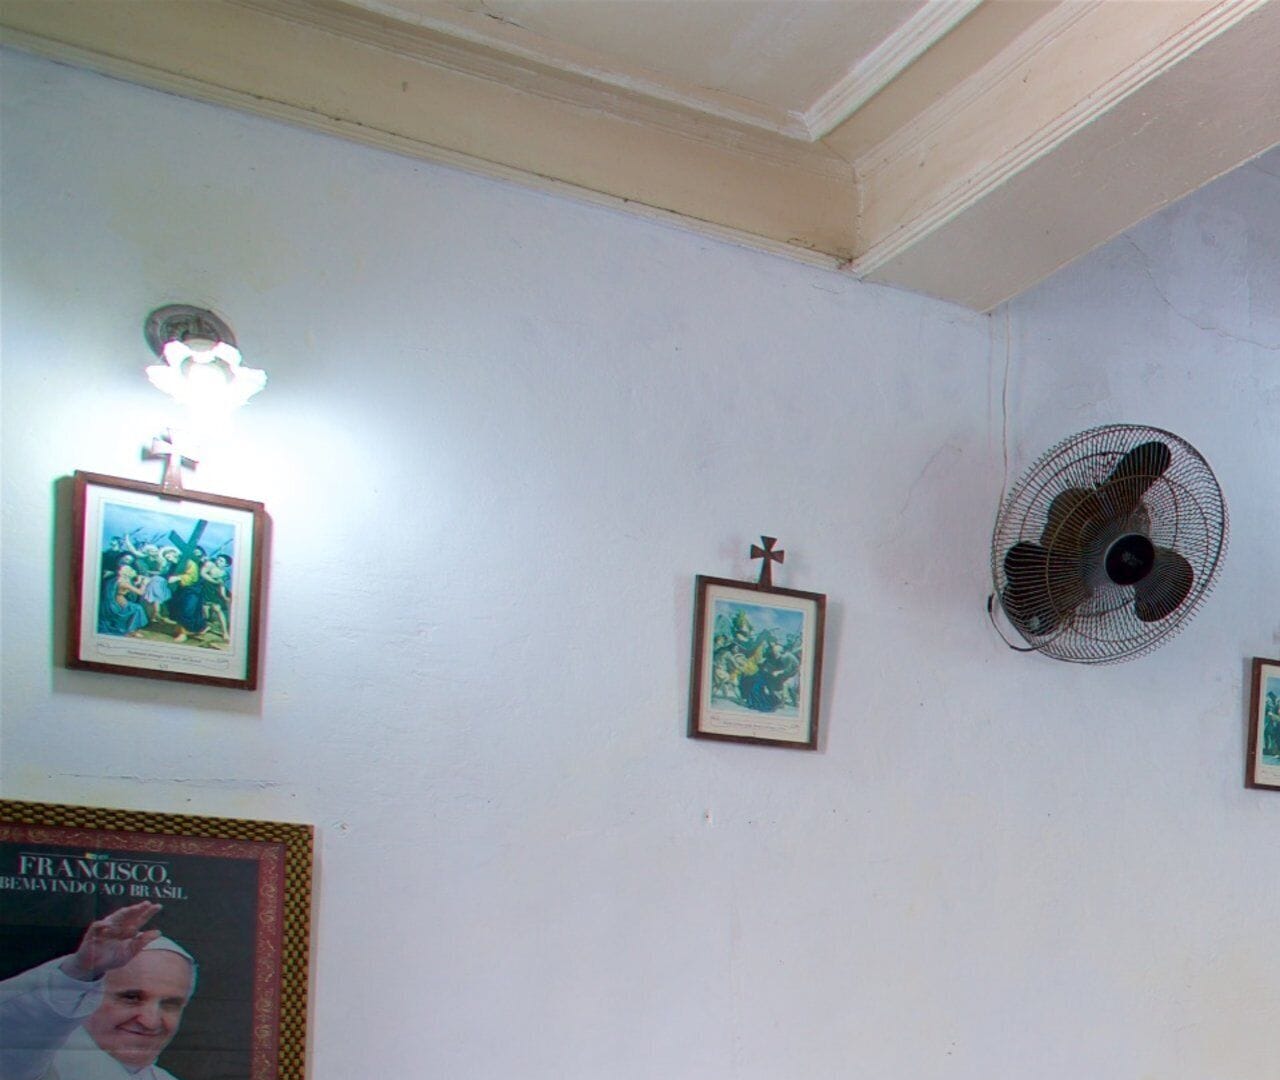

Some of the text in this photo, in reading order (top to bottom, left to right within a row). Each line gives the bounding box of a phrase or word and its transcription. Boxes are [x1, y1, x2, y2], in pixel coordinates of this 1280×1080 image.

[18, 855, 172, 885] FRANCISCO,
[0, 876, 96, 894] BEM-VINDO
[100, 882, 125, 896] AO
